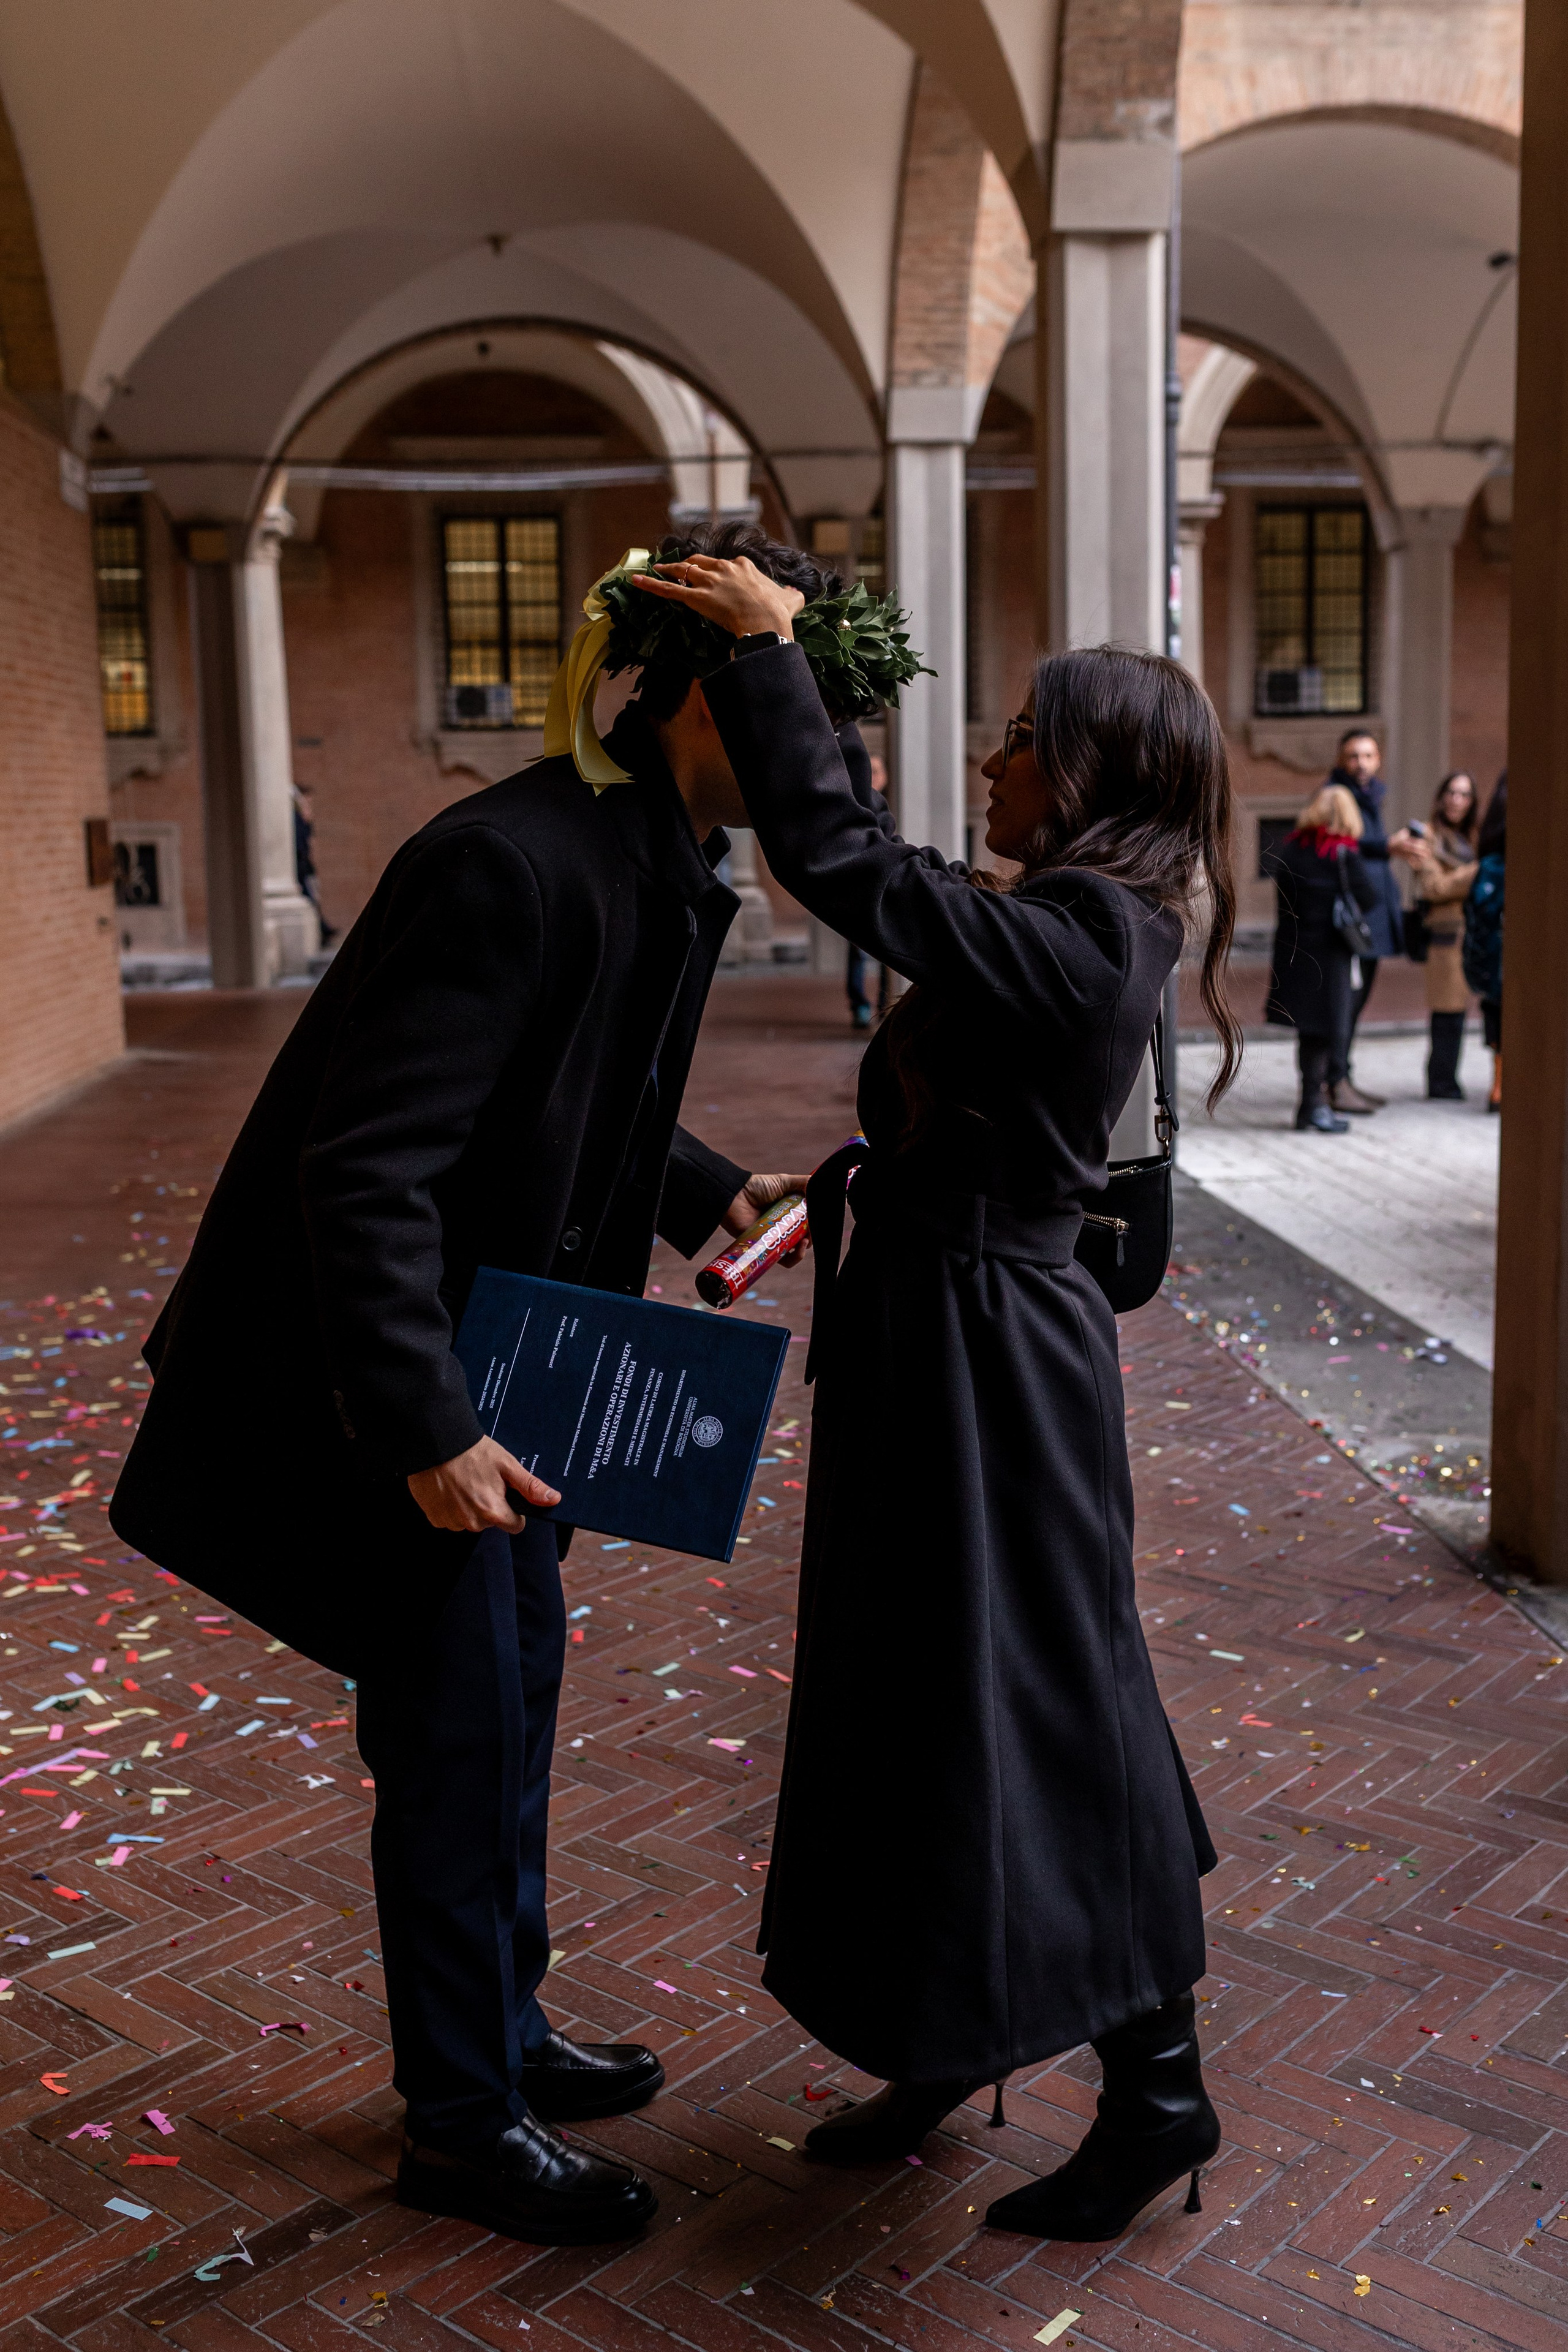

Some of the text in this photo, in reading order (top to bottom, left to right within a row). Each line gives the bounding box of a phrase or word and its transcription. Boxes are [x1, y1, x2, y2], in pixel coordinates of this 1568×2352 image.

[768, 1202, 792, 1219] IDEALE
[554, 1327, 564, 1346] Fabrizio
[569, 1318, 579, 1337] Relatore
[548, 1347, 558, 1368] Palmucci
[614, 1341, 631, 1384] AZIONARI
[590, 1360, 599, 1381] magistrale
[644, 1368, 655, 1393] FINANZA,
[654, 1372, 663, 1391] CORSO
[673, 1370, 686, 1405] DIPARTIMENTO
[597, 1392, 617, 1446] OPERAZIONI
[601, 1360, 636, 1464] FONDI DI INVESTIMENTO
[633, 1393, 648, 1435] INTERMEDIARI
[646, 1398, 656, 1421] LAUREA
[682, 1396, 693, 1425] UNIVERSITÀ
[663, 1411, 674, 1438] ECONOMIA
[594, 1446, 602, 1457] DI
[635, 1421, 649, 1458] MAGISTRALE
[673, 1432, 683, 1456] BOLOGNA
[677, 1428, 689, 1457] STUDIORUM
[527, 1454, 539, 1474] Presenta
[624, 1439, 635, 1466] MERCATI
[653, 1442, 666, 1477] MANAGEMENT
[587, 1458, 599, 1479] M&A
